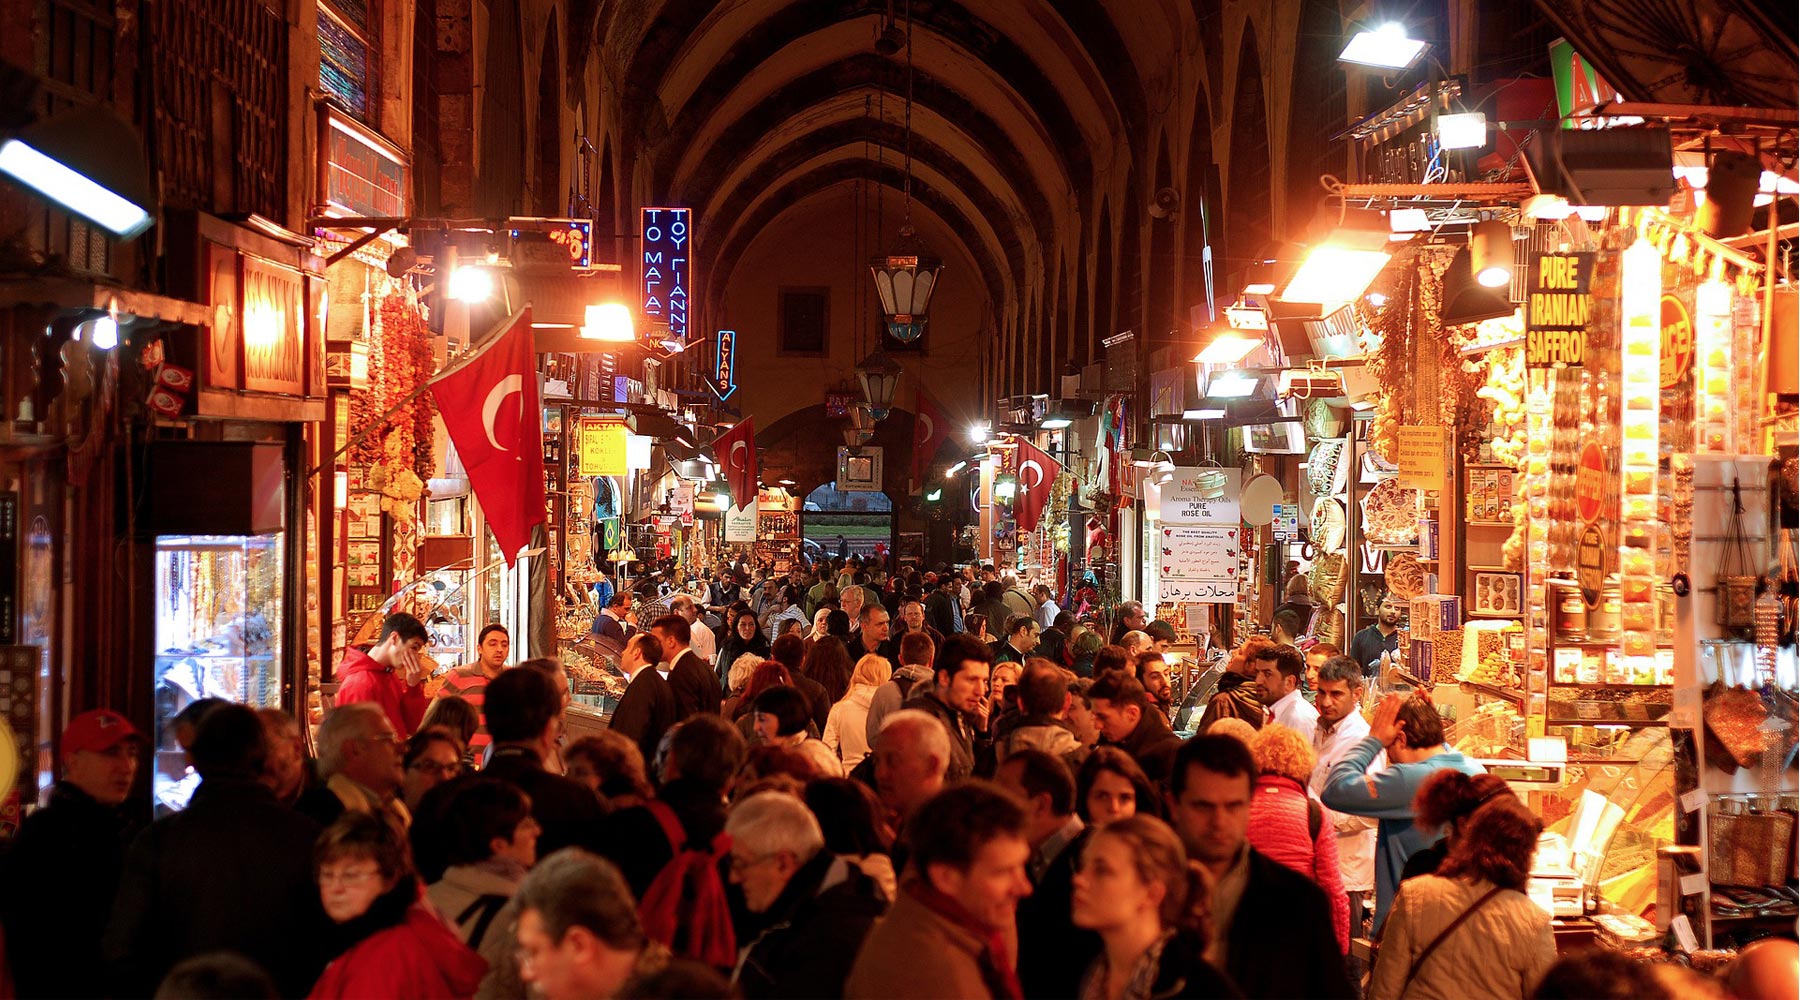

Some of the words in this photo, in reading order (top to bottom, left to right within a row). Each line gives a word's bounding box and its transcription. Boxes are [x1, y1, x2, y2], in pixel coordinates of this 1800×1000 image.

[671, 210, 686, 250] ΤΟΥ
[1539, 256, 1579, 290] PURE
[1530, 293, 1590, 326] IRANIAN
[720, 333, 730, 390] ALYANS
[1161, 585, 1190, 600] برهان
[1195, 585, 1234, 597] محلات
